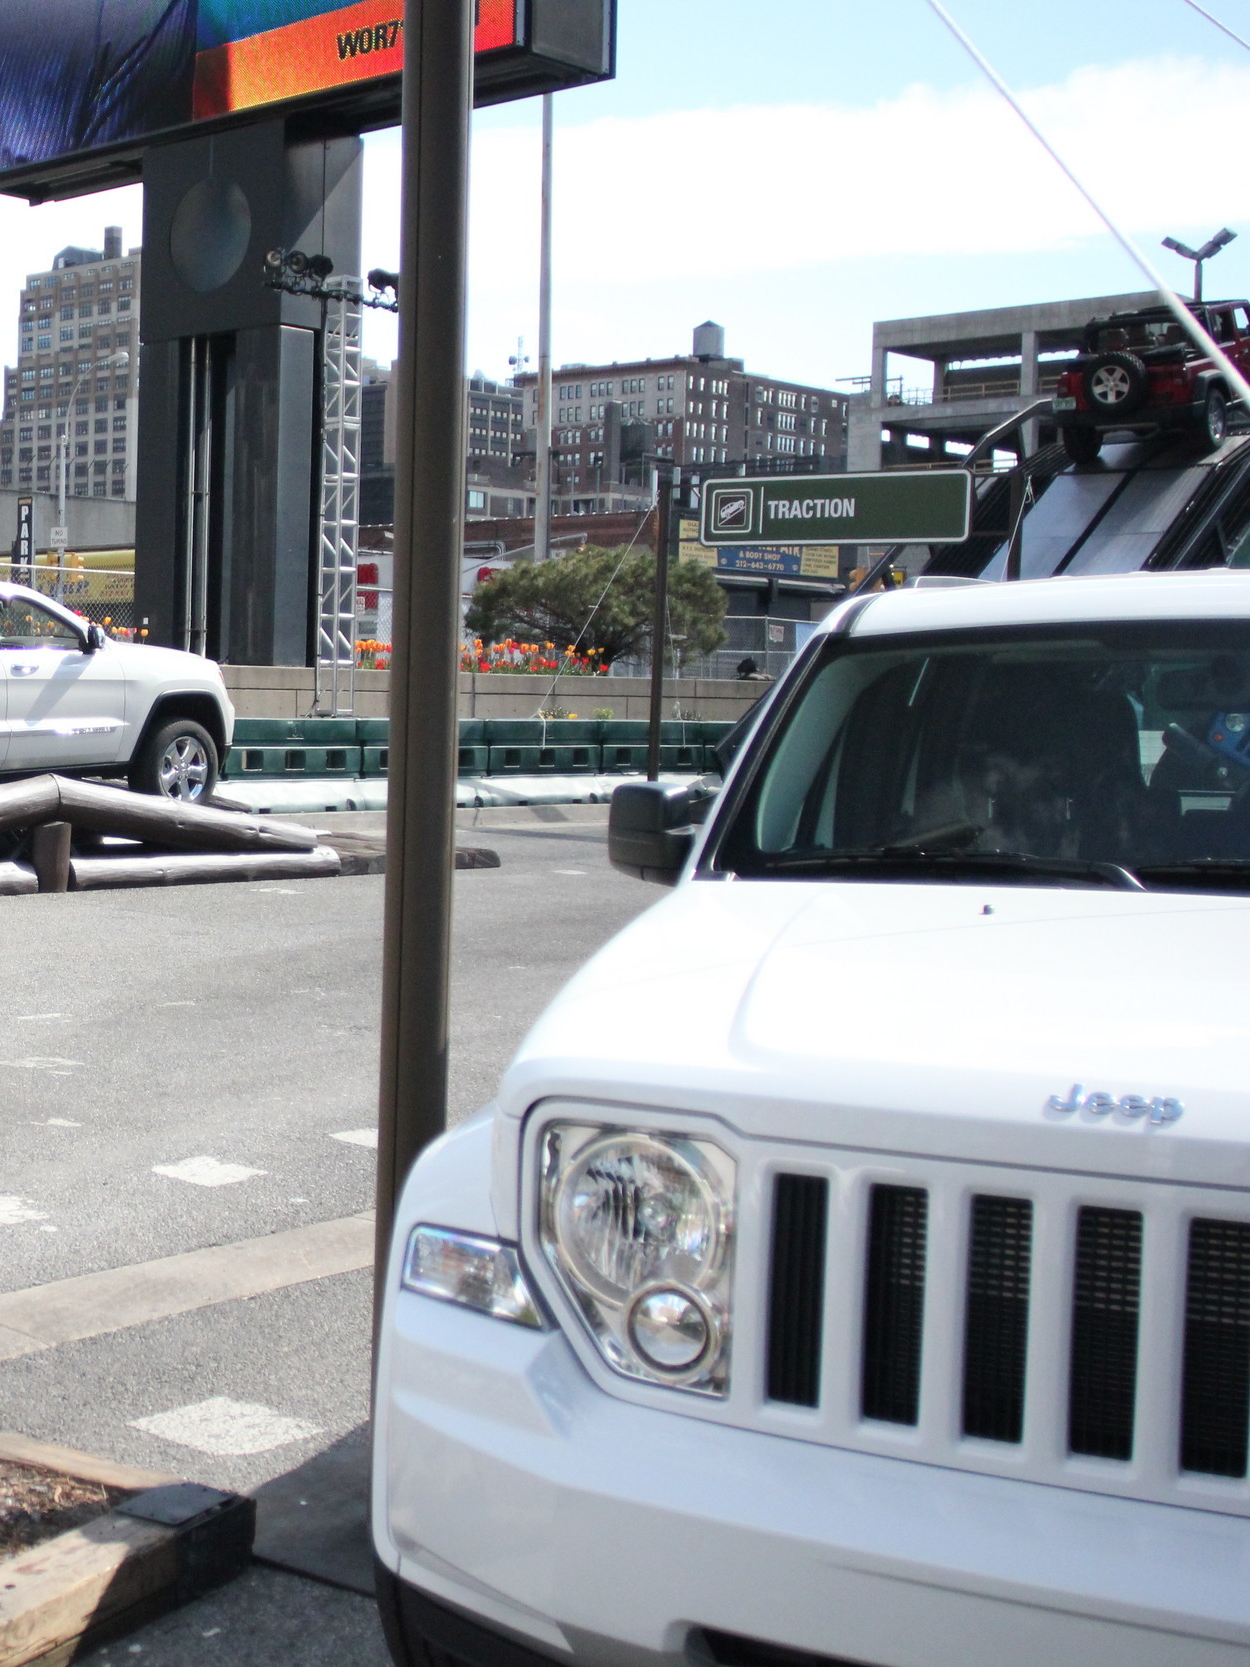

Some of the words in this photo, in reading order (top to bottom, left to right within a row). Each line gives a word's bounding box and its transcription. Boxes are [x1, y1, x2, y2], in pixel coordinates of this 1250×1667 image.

[767, 498, 856, 519] TRACTION
[20, 505, 29, 573] PARK
[735, 560, 785, 571] 212-643-6770
[746, 551, 762, 559] BODY
[764, 552, 781, 561] SHOP
[1047, 1083, 1185, 1125] Jeep
